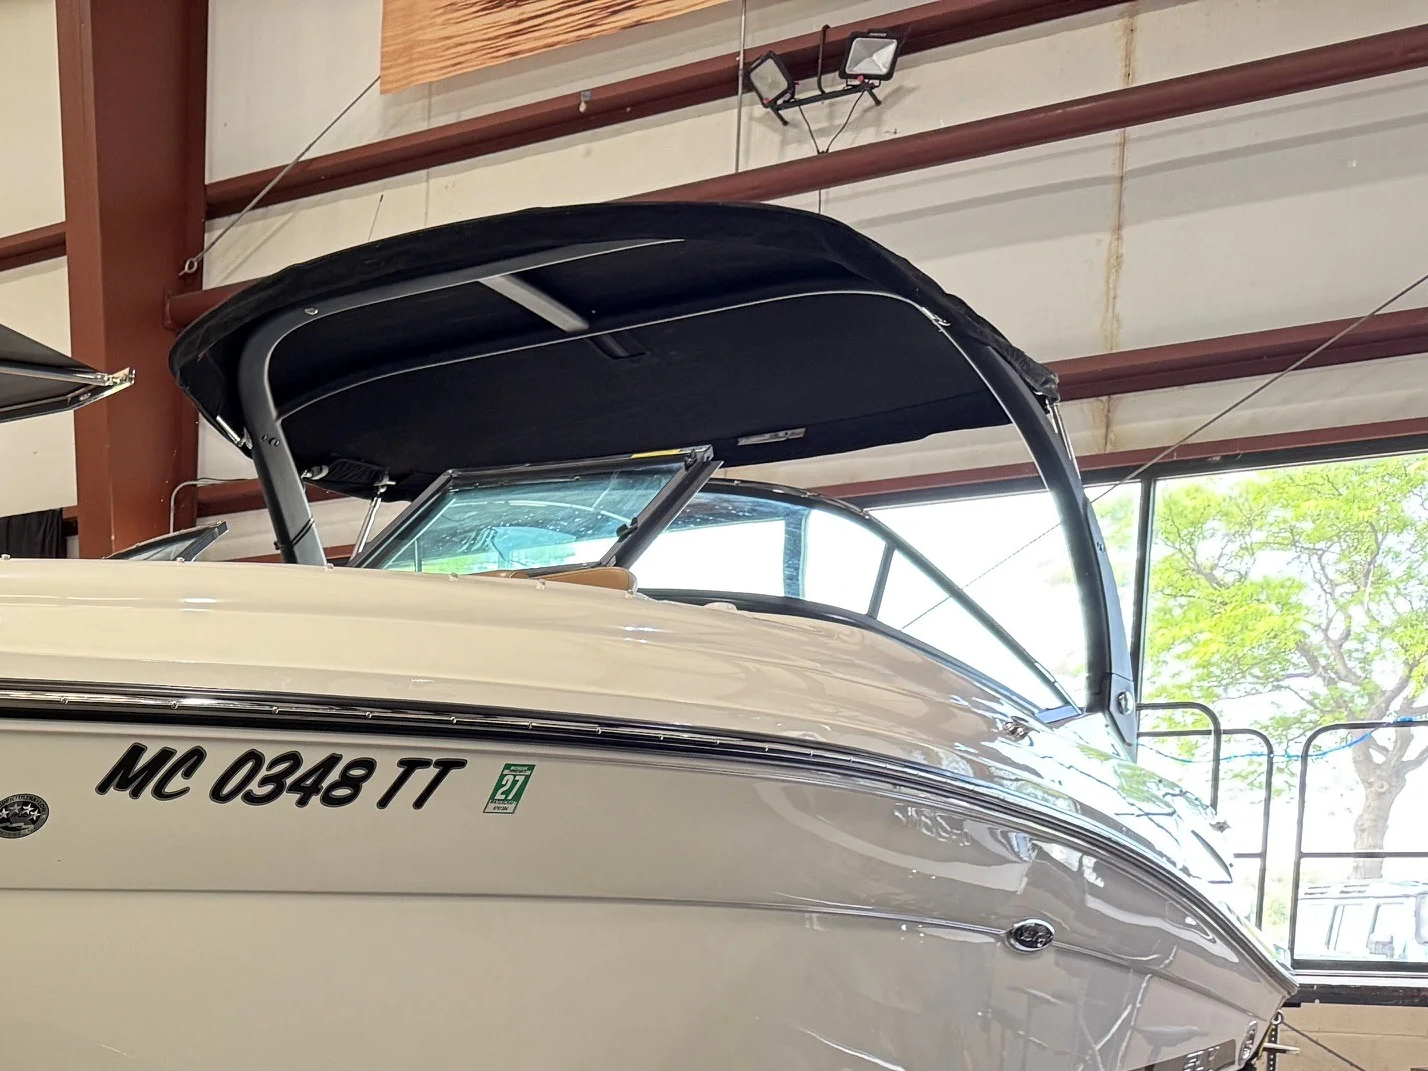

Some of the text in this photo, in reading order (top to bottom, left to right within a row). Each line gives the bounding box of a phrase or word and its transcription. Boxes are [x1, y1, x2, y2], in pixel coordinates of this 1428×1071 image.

[95, 742, 468, 810] MC 0348 TT
[494, 774, 526, 800] 27
